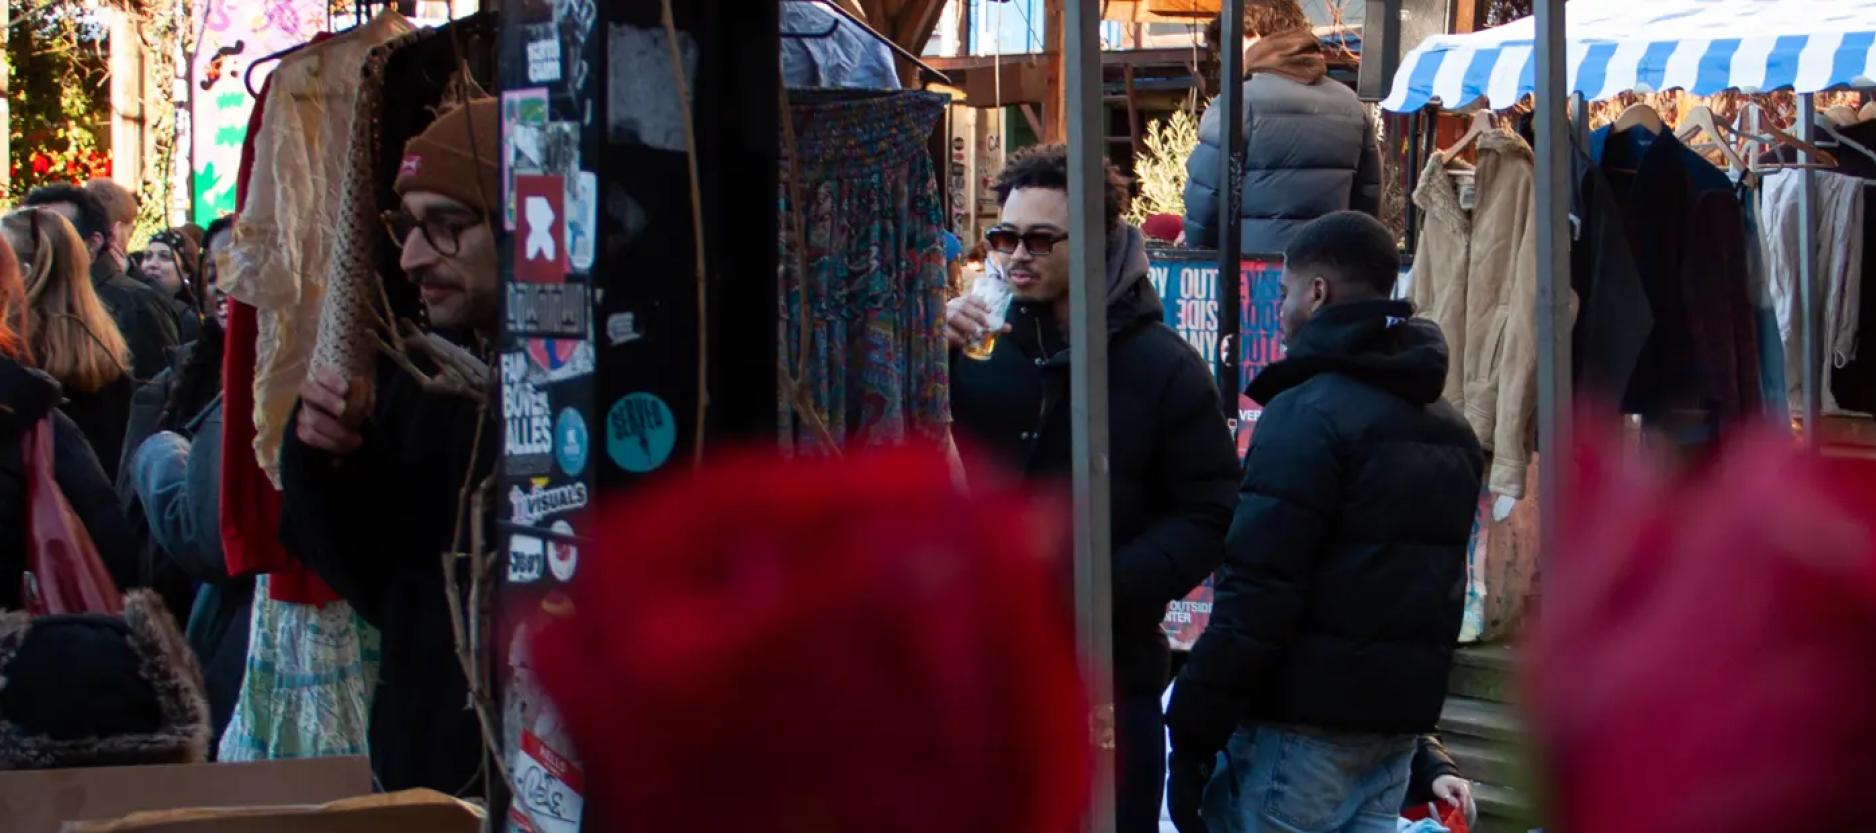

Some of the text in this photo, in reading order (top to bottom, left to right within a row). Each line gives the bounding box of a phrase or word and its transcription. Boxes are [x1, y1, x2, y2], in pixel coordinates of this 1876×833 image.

[1180, 268, 1219, 299] OUT
[505, 417, 552, 455] ALLES
[527, 487, 585, 513] VISUALS
